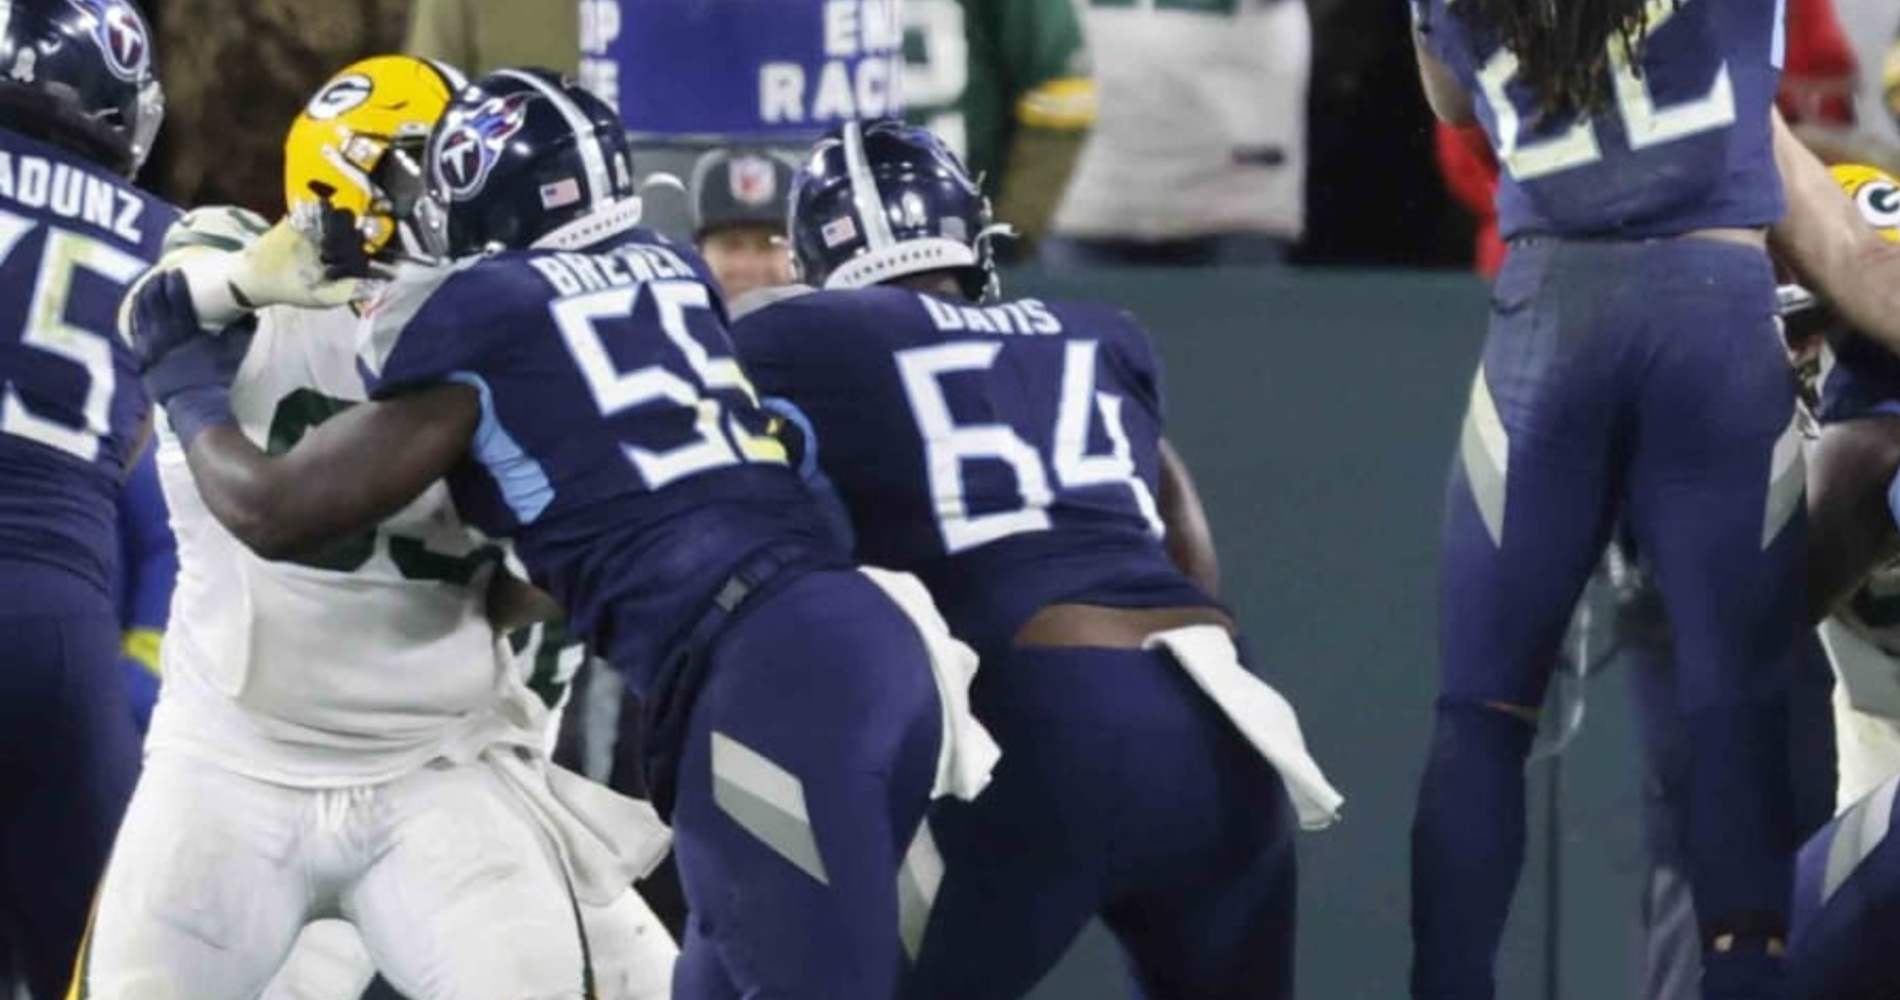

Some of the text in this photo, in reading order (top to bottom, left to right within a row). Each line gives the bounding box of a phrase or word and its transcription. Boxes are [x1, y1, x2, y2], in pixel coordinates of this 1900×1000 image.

[548, 278, 790, 487] 55
[918, 292, 1063, 335] DAVIS
[892, 338, 1166, 555] 64
